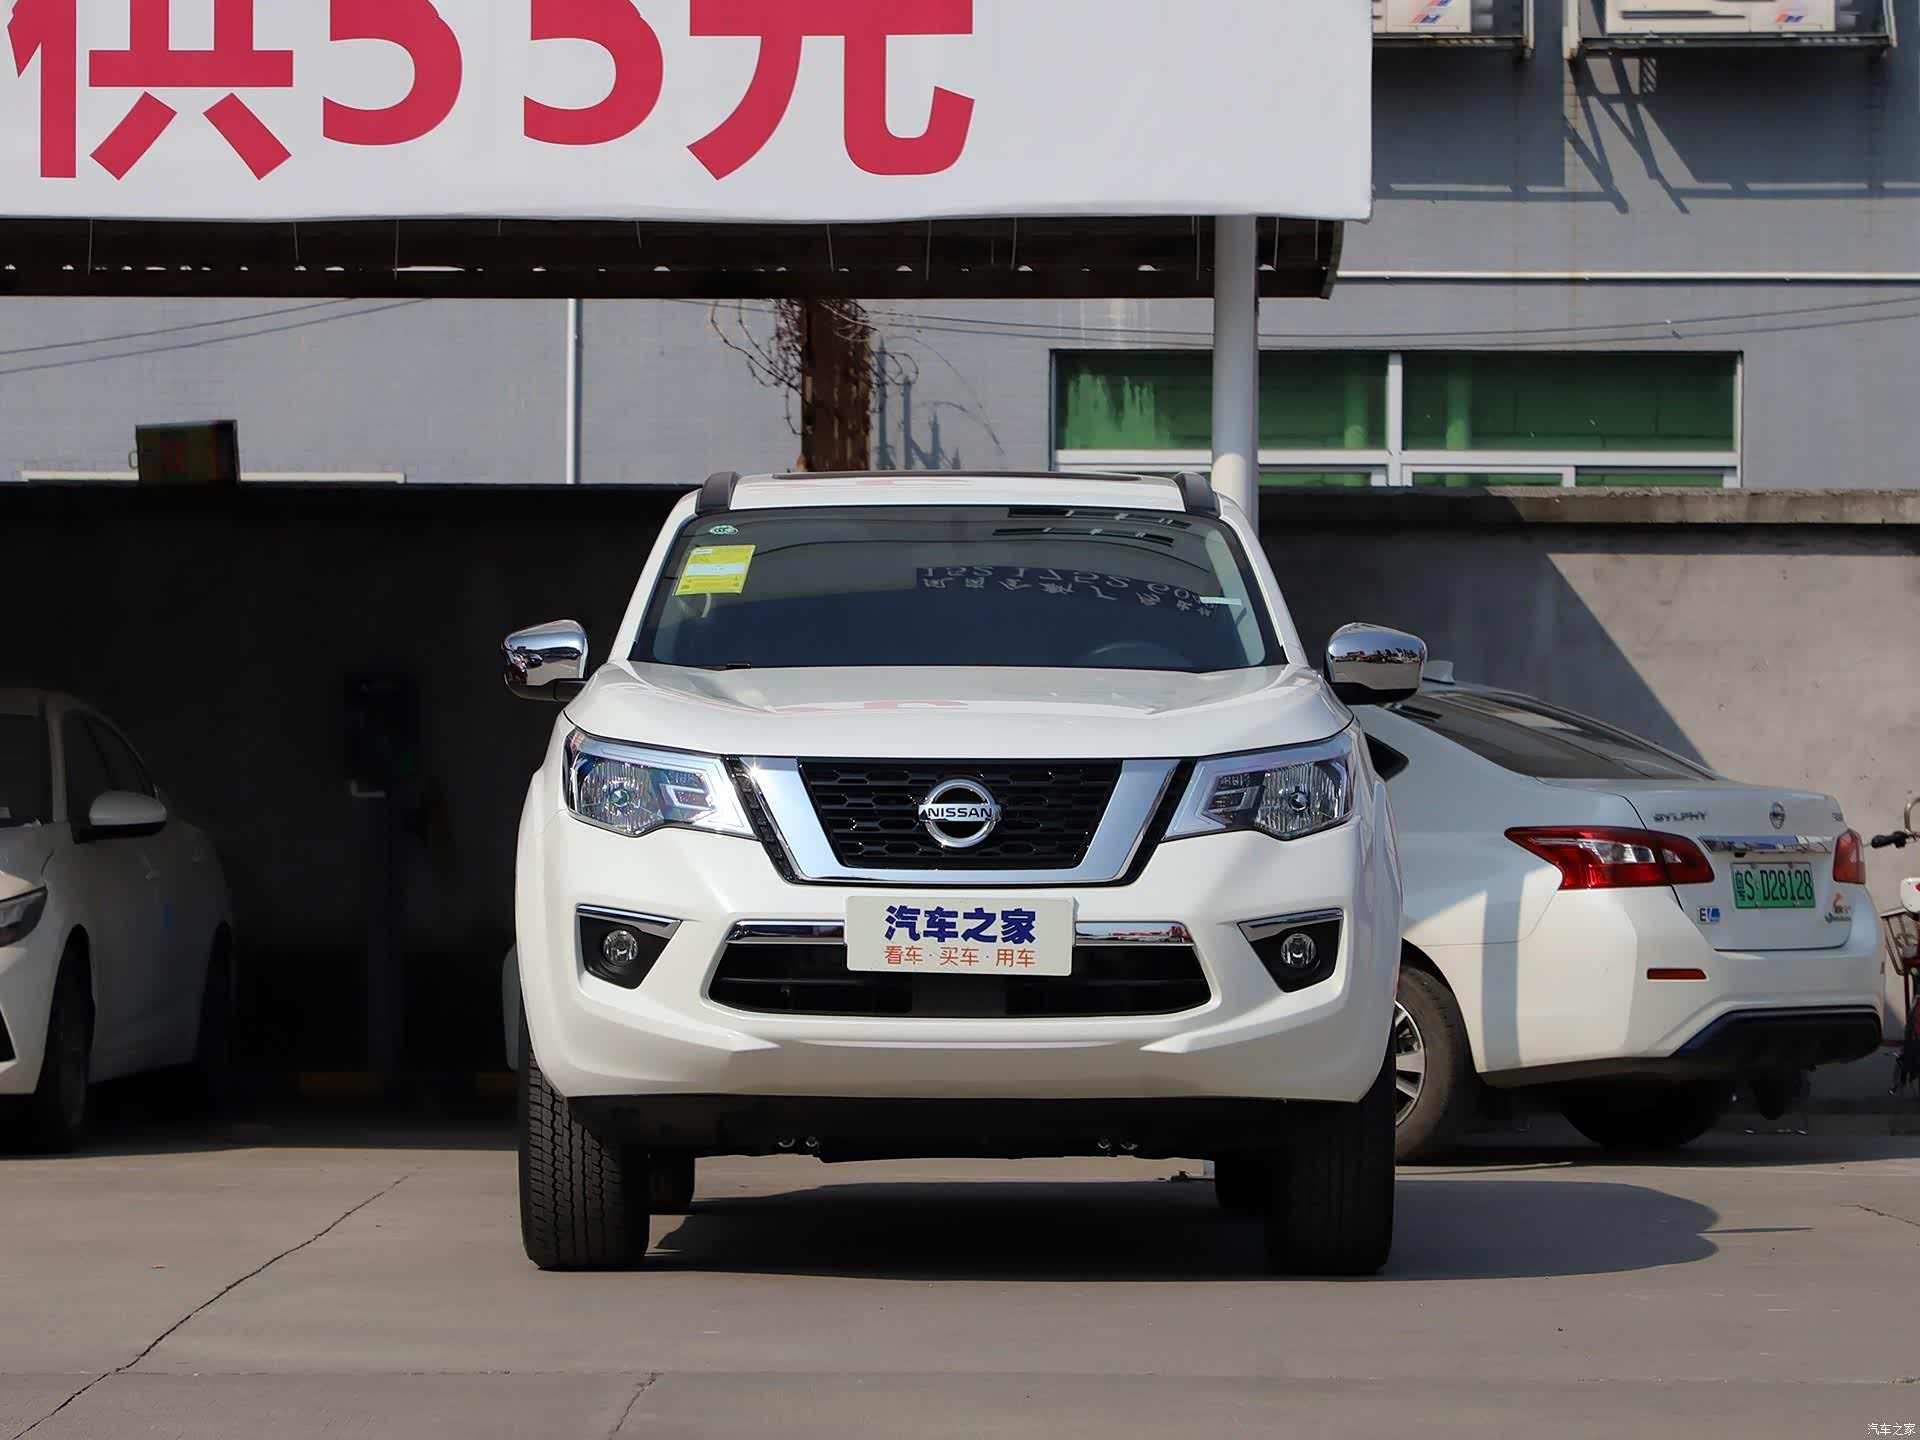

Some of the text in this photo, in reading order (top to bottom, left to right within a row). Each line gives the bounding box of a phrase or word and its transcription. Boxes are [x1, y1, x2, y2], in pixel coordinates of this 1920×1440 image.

[927, 806, 993, 819] NISSAN
[884, 904, 1036, 945] 汽车之家
